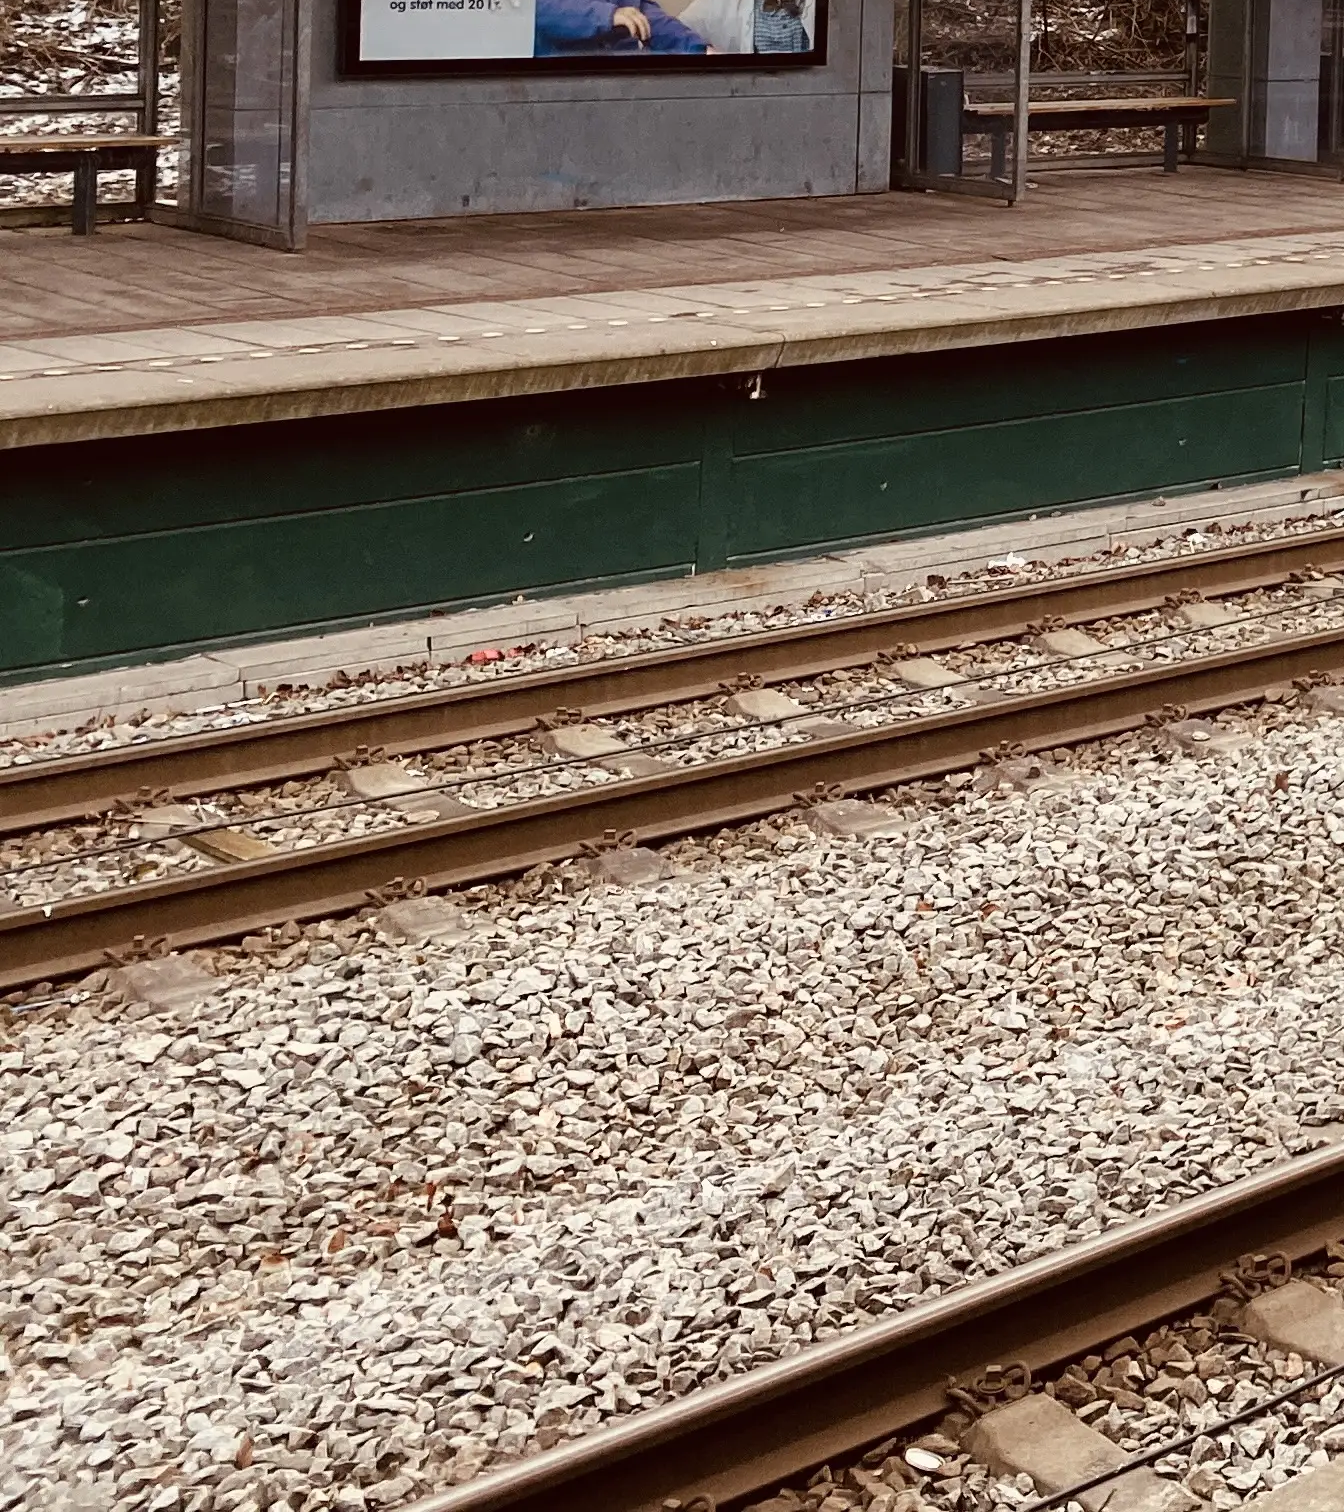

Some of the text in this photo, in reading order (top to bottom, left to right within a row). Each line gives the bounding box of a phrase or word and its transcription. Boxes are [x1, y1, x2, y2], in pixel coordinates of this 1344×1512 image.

[390, 0, 406, 12] og
[410, 0, 433, 10] støt
[436, 0, 464, 10] med
